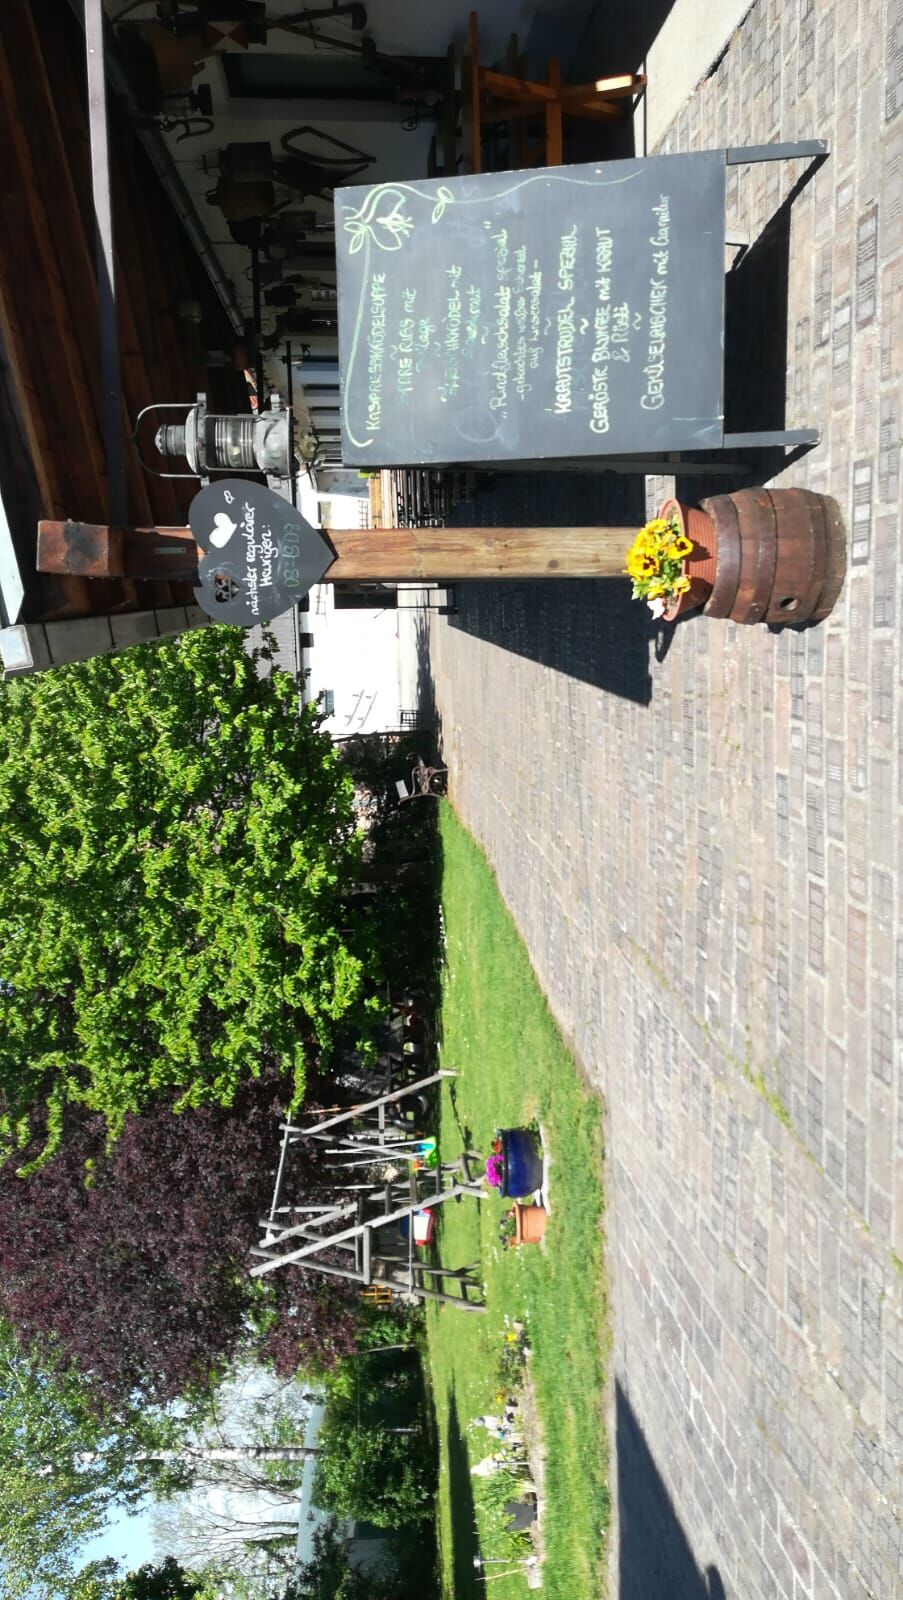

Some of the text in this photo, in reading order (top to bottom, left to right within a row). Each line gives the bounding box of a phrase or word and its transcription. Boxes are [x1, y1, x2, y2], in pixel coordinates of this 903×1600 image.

[595, 226, 612, 272] KRAUT
[654, 249, 670, 275] mit
[402, 288, 416, 313] mit
[594, 275, 611, 301] mit
[553, 296, 576, 414] KRAUTSTRUDEL
